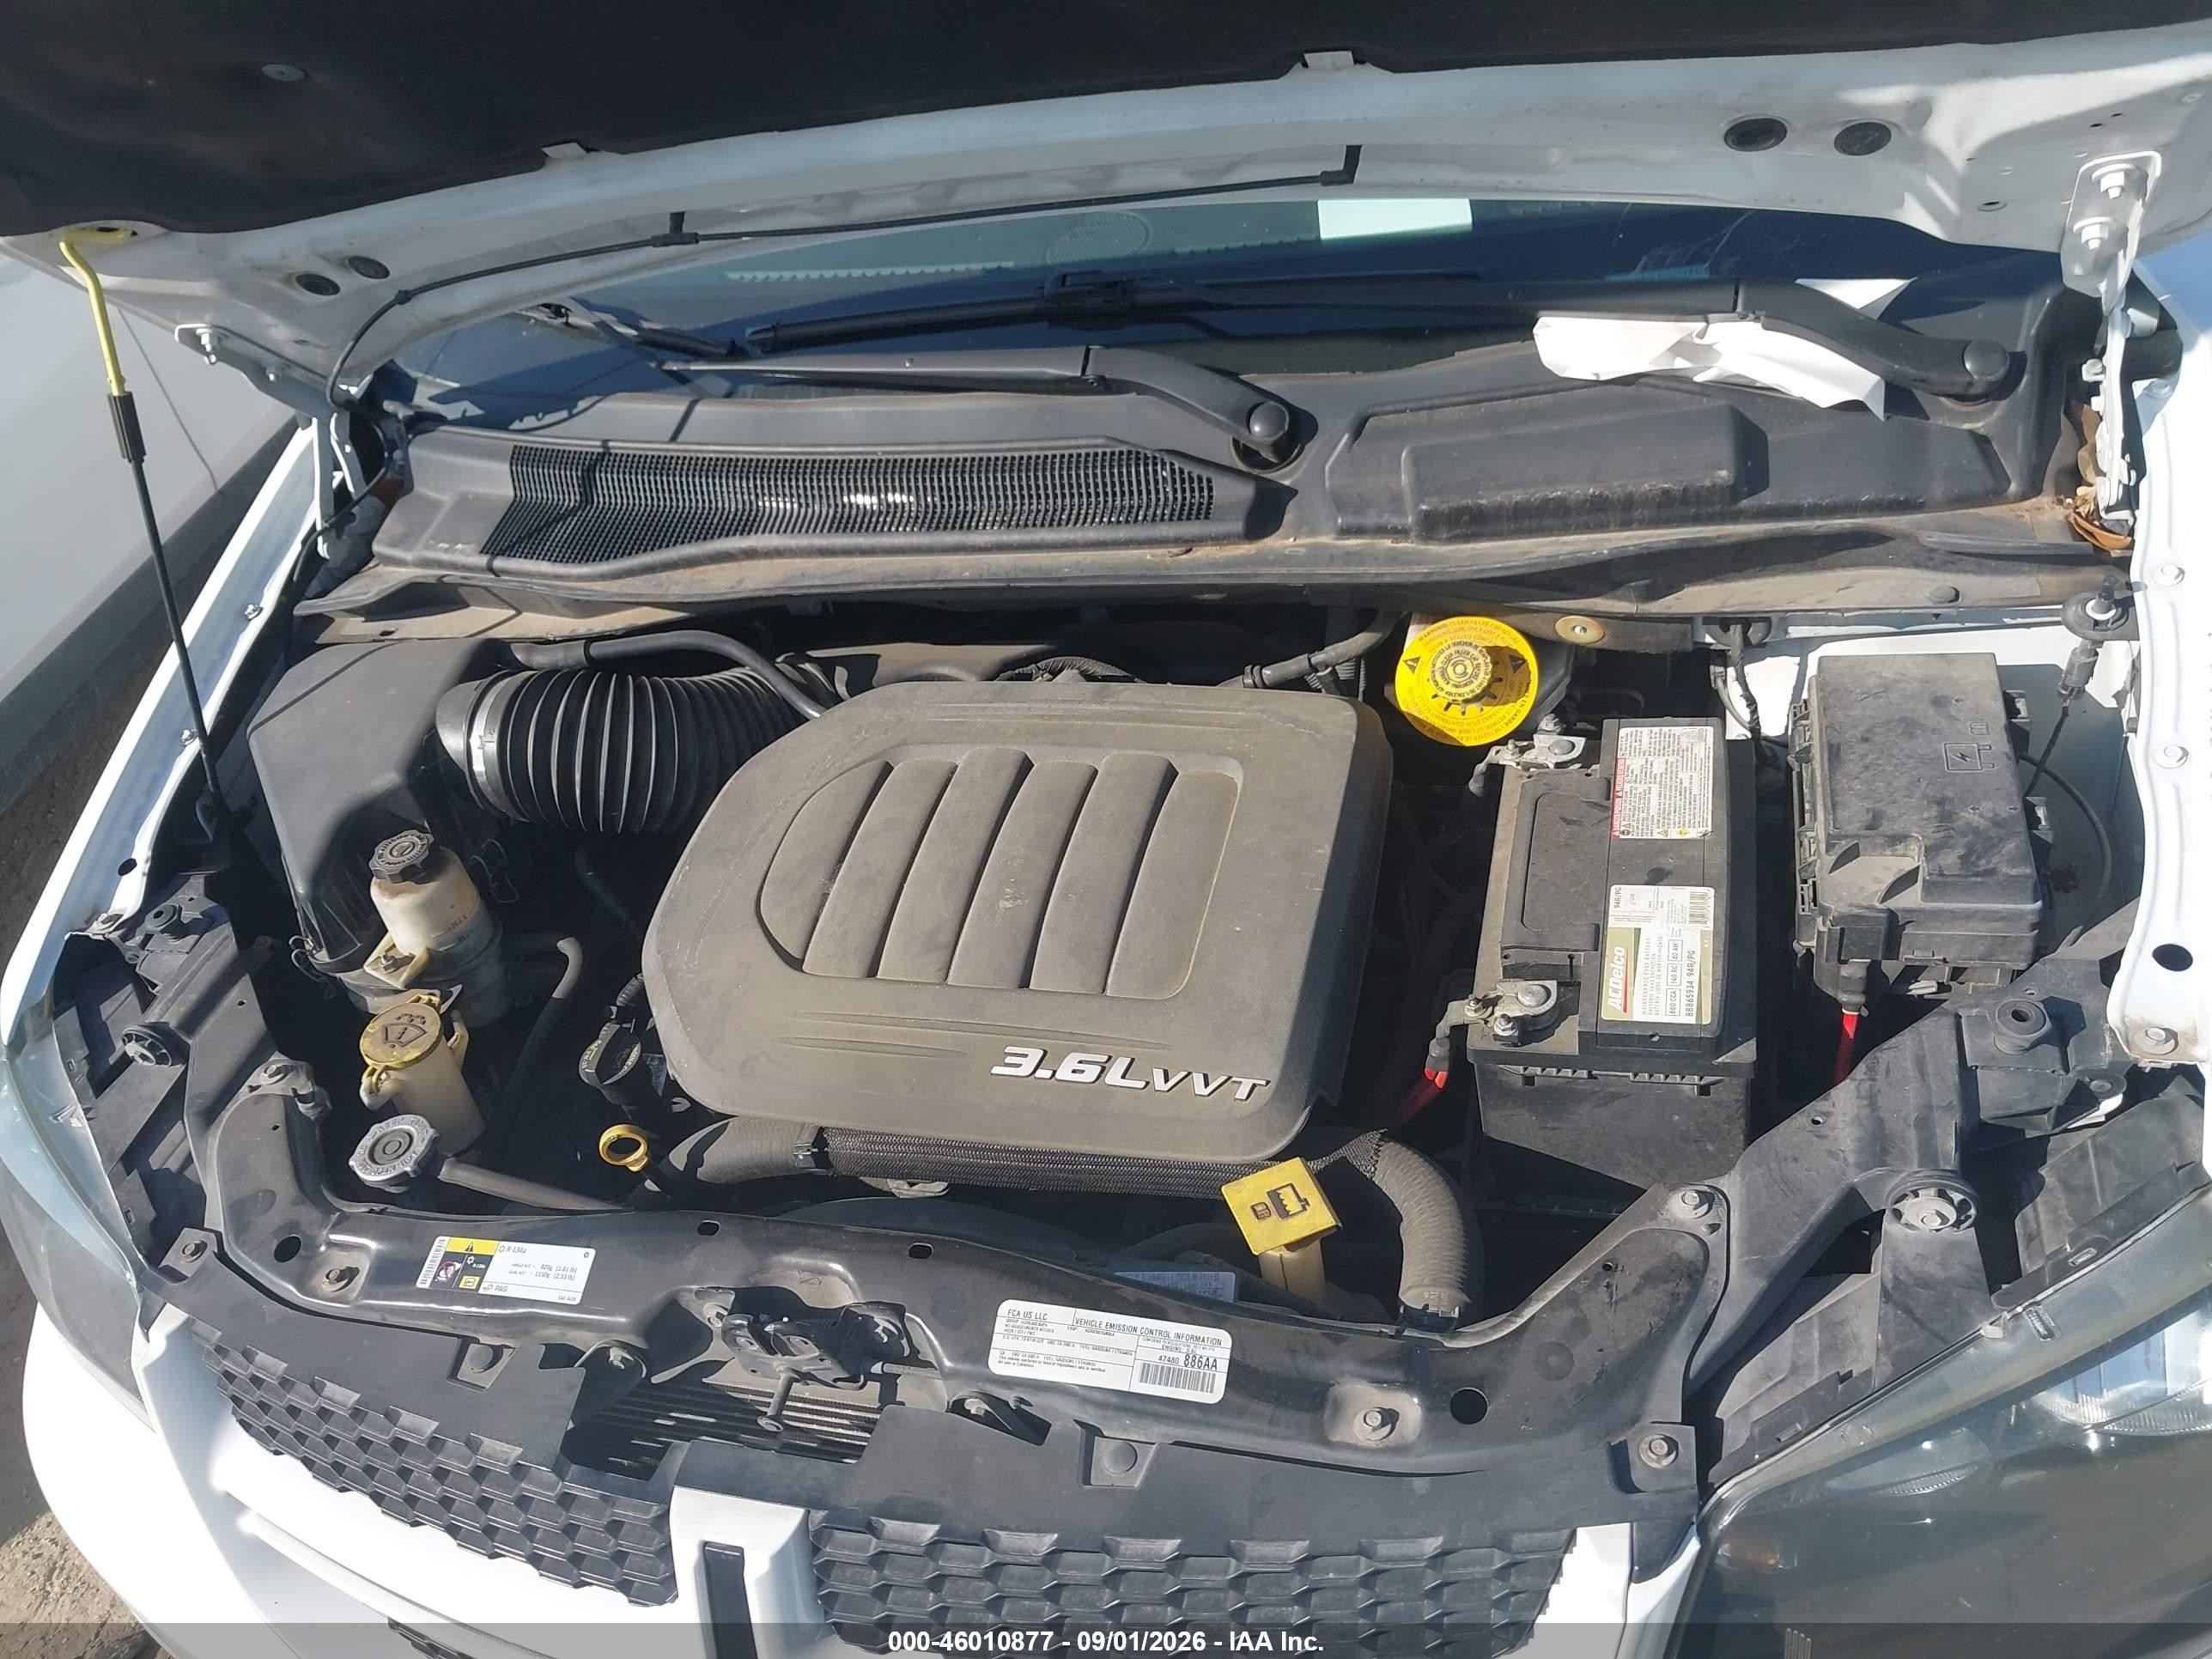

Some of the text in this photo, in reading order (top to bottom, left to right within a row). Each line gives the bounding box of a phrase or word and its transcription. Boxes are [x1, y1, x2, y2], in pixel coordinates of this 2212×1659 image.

[1607, 946, 1625, 1012] ACDelco
[1671, 965, 1678, 974] RC
[1685, 950, 1697, 1017] 88865934 94R/PG
[990, 1046, 1271, 1102] 3.6L VVT
[1007, 1309, 1020, 1317] FCA
[1035, 1312, 1048, 1321] LLC
[1075, 1317, 1103, 1328] VEHICLE
[1104, 1322, 1137, 1333] EMISSION
[1139, 1327, 1171, 1338] CONTROL
[1173, 1333, 1222, 1346] INFORMATION
[1183, 1354, 1218, 1370] 886AA
